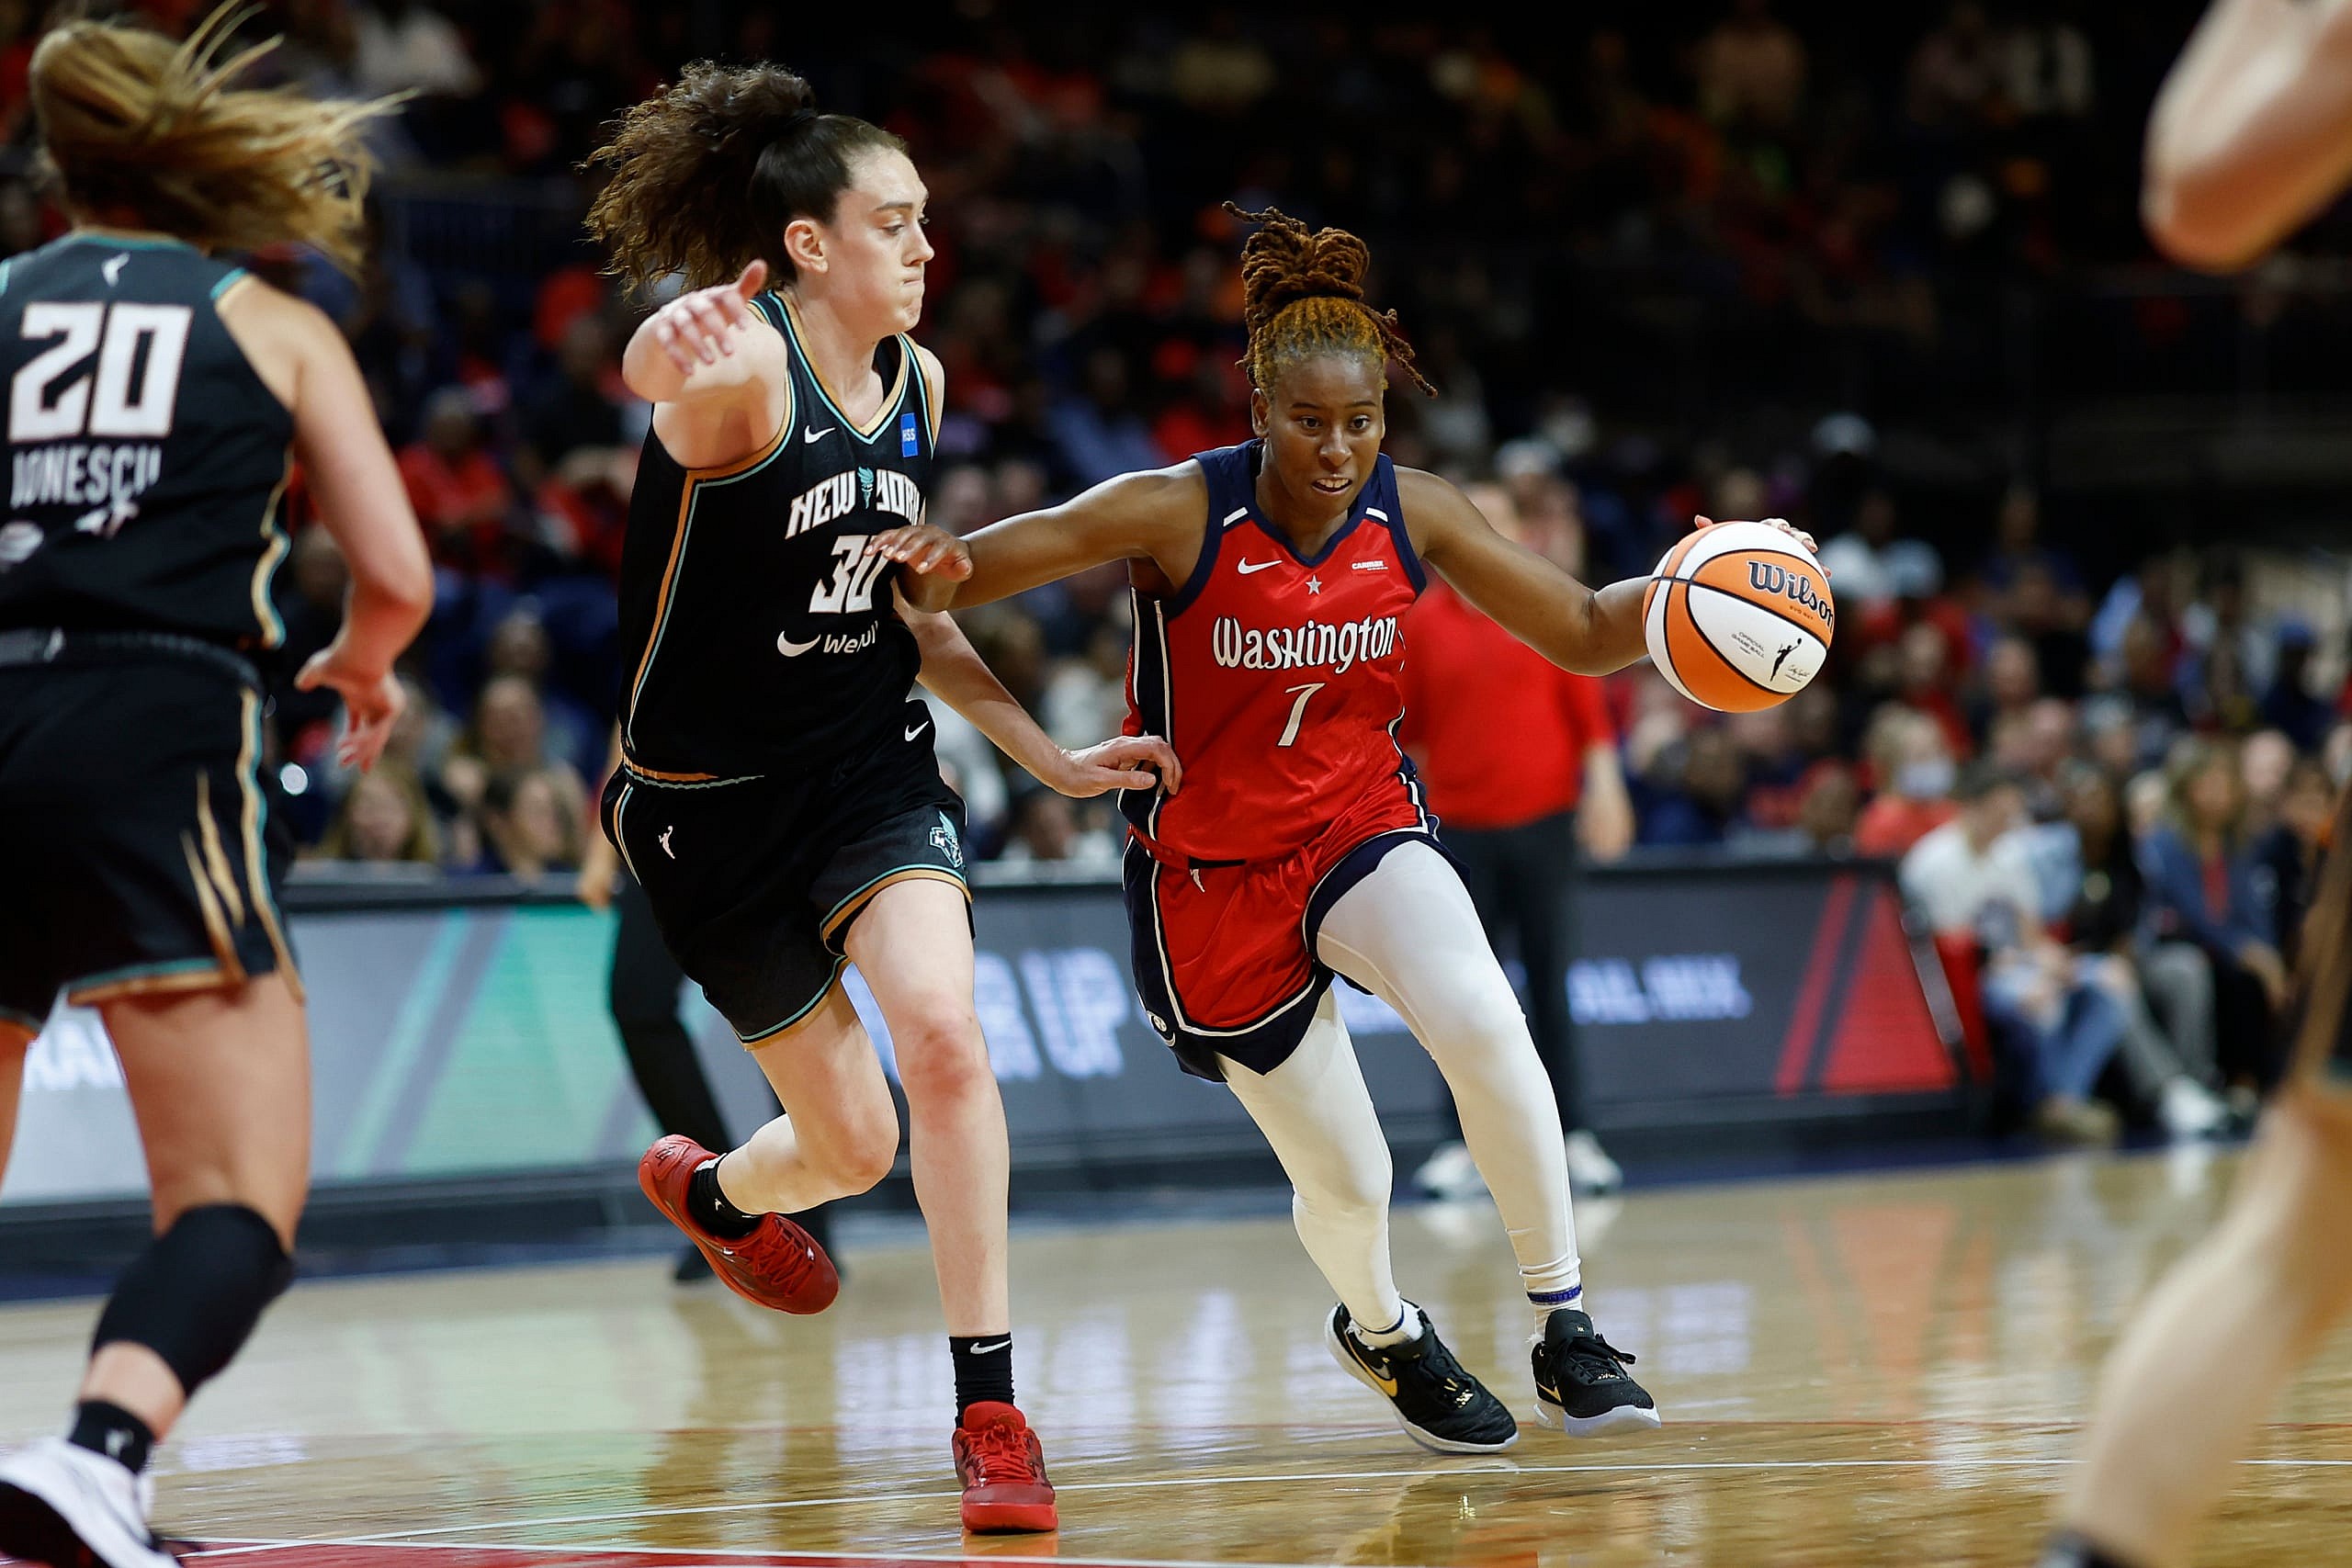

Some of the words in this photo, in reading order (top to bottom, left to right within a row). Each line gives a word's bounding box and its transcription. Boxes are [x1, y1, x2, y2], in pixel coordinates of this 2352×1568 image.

[8, 302, 194, 444] 20
[902, 427, 916, 441] HSS
[786, 469, 856, 540] NEW
[808, 536, 888, 614] 30
[1747, 559, 1834, 634] Wilson
[1213, 615, 1396, 673] Washington
[1278, 682, 1326, 747] 7
